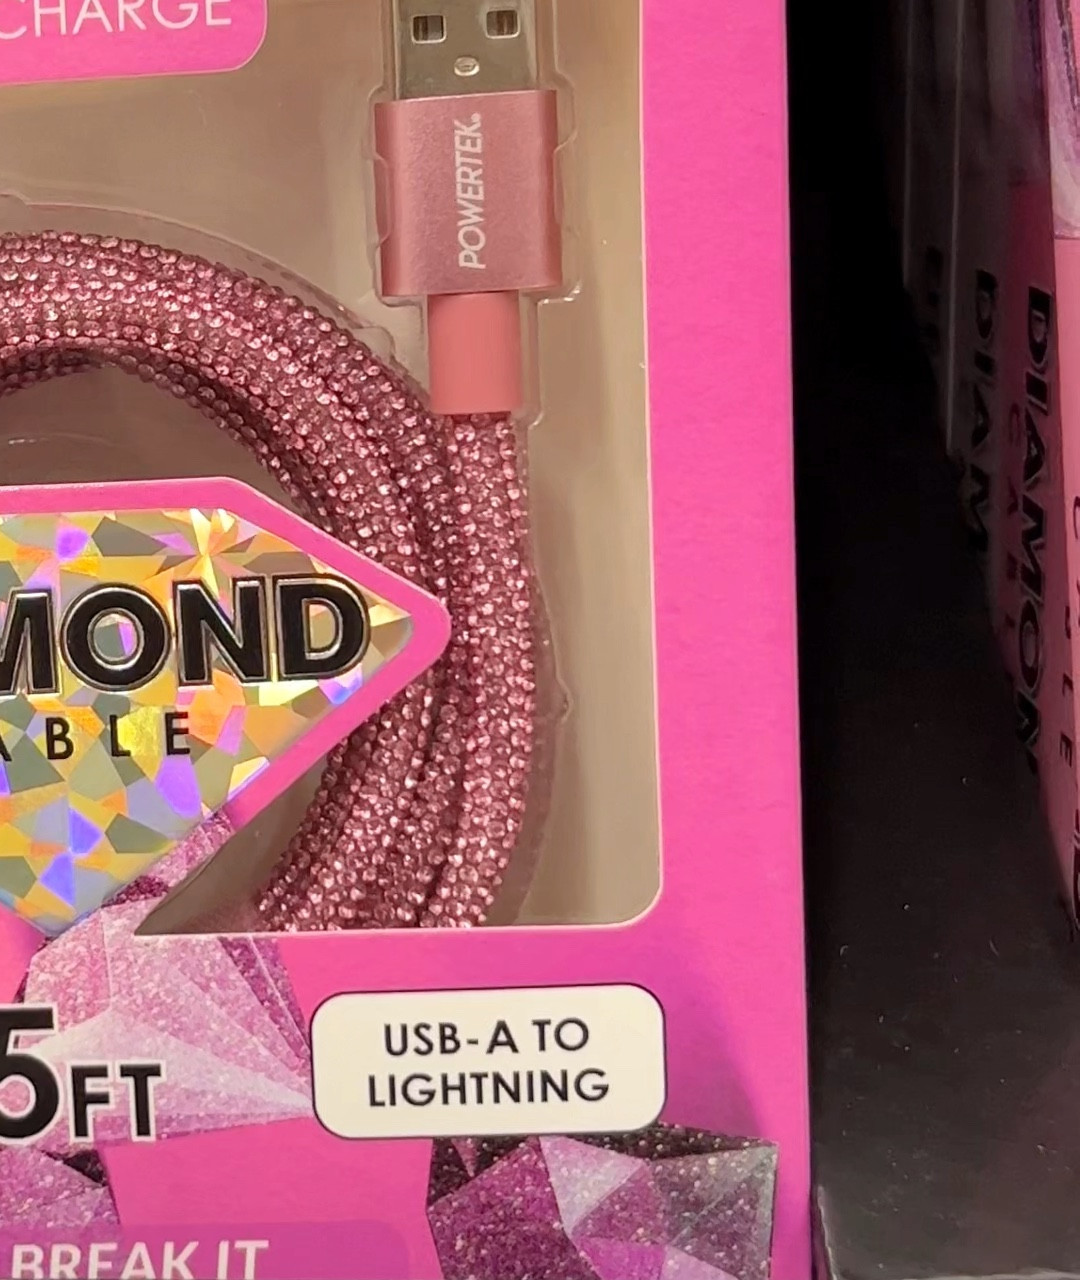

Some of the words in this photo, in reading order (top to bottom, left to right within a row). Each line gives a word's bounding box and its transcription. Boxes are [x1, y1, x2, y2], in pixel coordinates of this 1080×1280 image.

[383, 1020, 519, 1057] USB-A
[531, 1017, 590, 1052] TO
[368, 1067, 610, 1108] LIGHTNING
[11, 1241, 200, 1280] BREAK
[216, 1239, 270, 1280] IT
